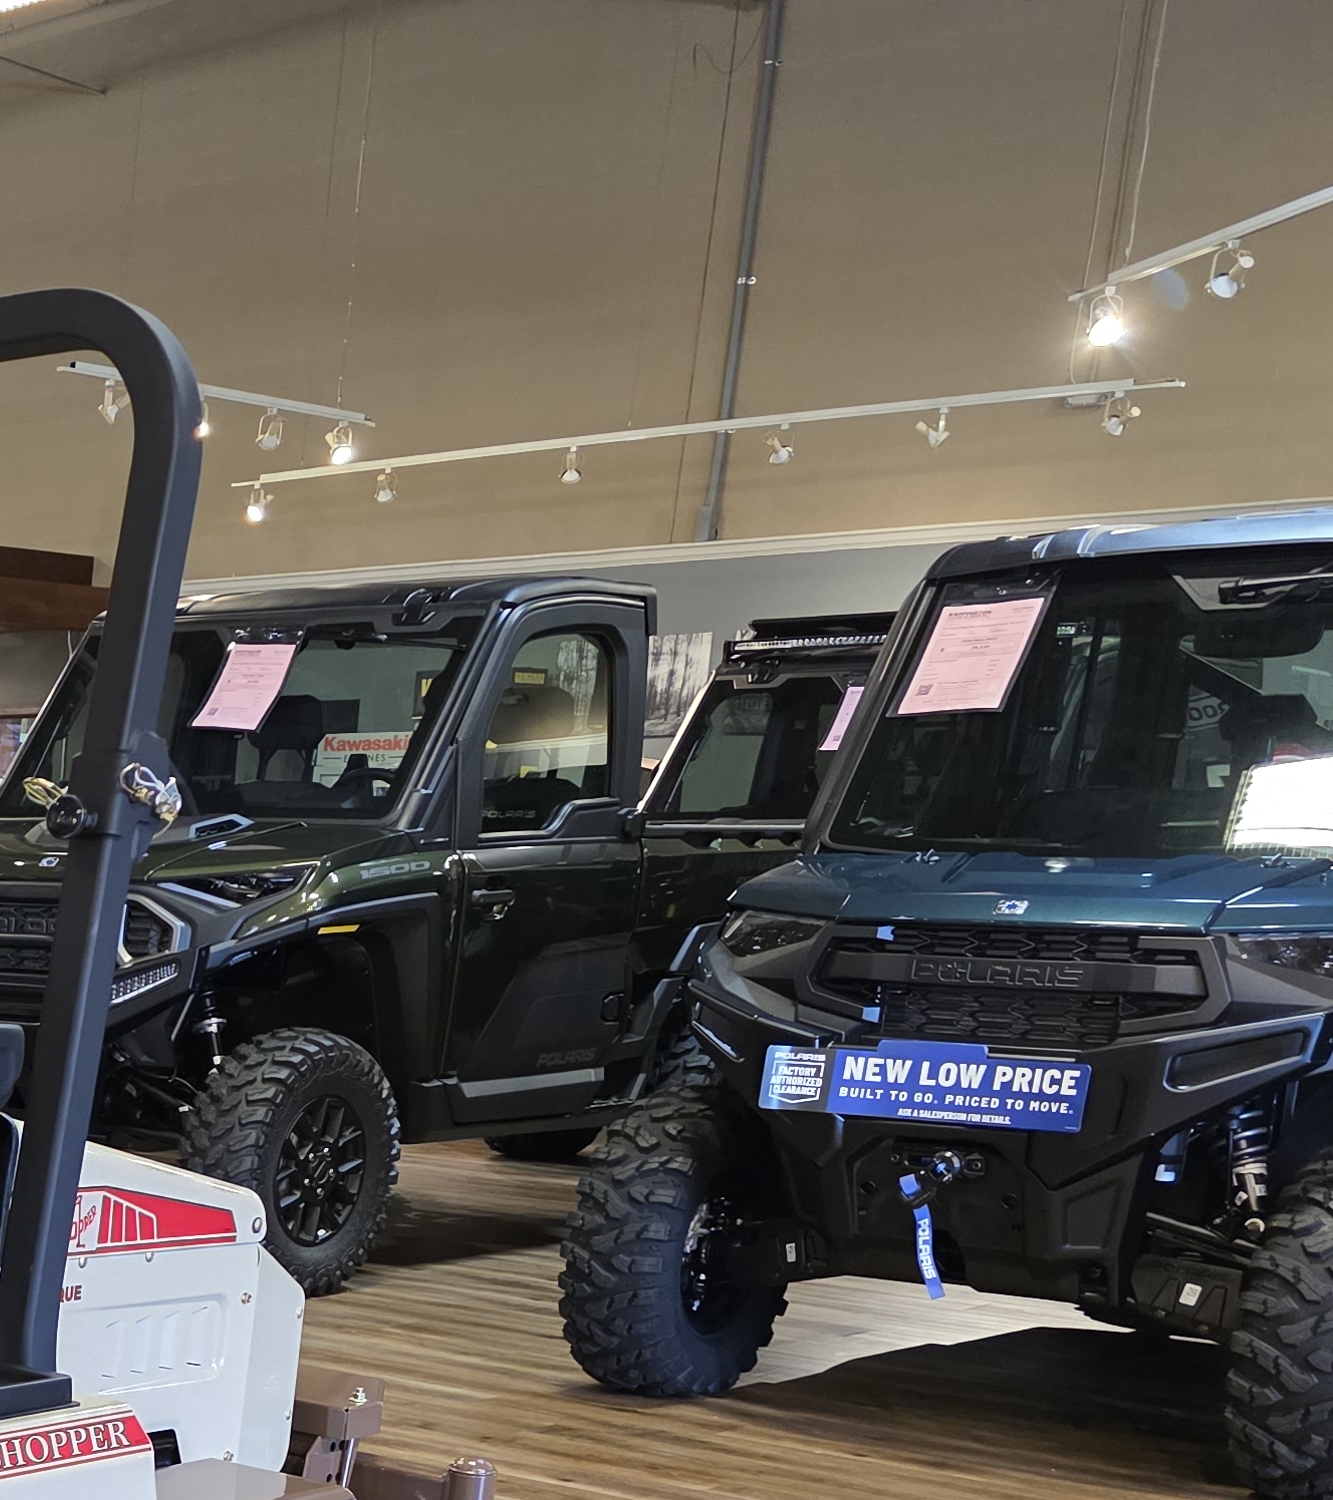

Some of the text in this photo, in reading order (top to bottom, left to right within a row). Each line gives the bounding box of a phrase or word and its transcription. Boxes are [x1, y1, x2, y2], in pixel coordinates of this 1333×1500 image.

[324, 735, 410, 752] Kawasaki
[343, 753, 386, 763] ENES
[360, 861, 430, 880] 1500
[911, 958, 1084, 987] POLARIS
[775, 1052, 826, 1061] POLARIS
[778, 1066, 817, 1076] FACTORY
[842, 1056, 1081, 1096] NEW LOW PRICE
[770, 1076, 823, 1087] AUTHORIZED
[773, 1085, 817, 1095] CLEARANCE
[839, 1086, 1073, 1115] BUILT TO GO. PRICED TO MOVE.
[897, 1107, 912, 1117] ASK
[912, 1108, 918, 1118] A
[919, 1109, 968, 1121] SALESPERSON
[968, 1112, 981, 1122] FOR
[59, 1285, 83, 1302] QUE
